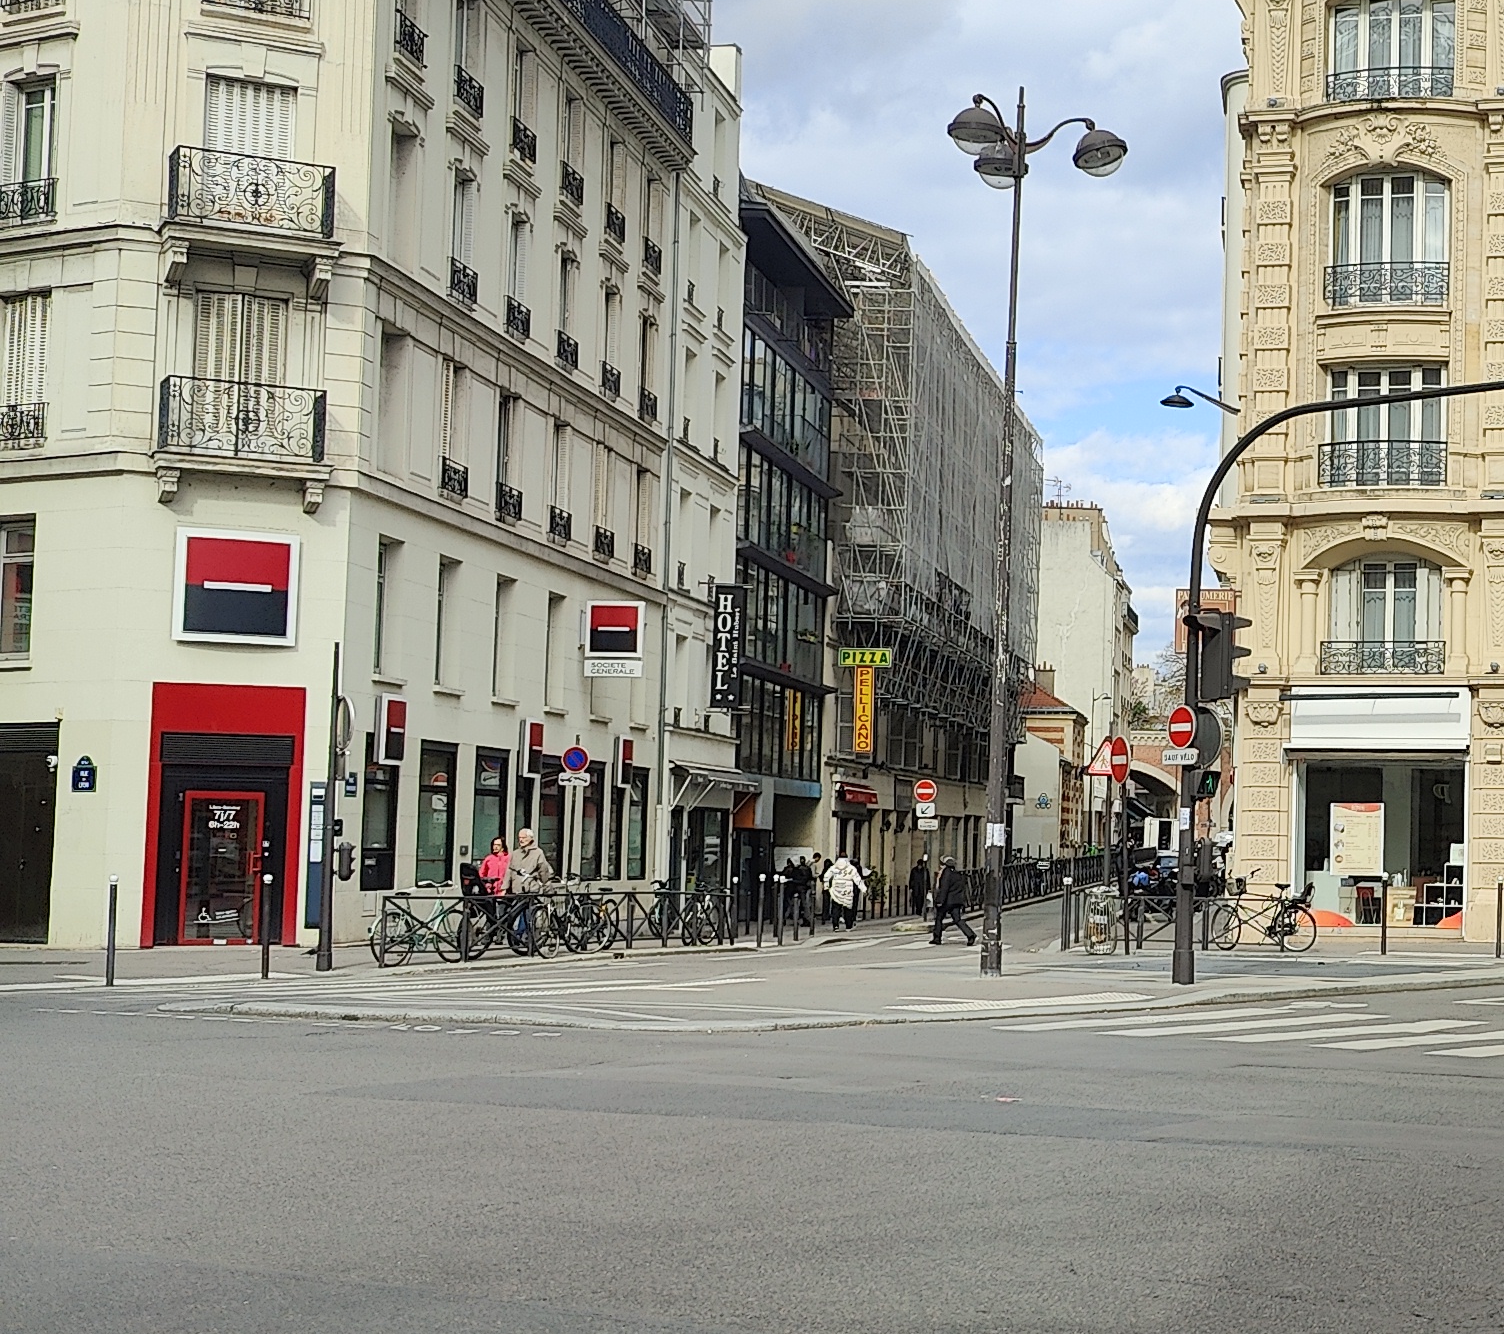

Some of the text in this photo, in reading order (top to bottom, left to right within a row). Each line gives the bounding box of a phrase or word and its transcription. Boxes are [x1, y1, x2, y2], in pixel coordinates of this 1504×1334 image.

[1177, 590, 1234, 601] PAUMERIE
[715, 594, 734, 689] HOTEL
[842, 651, 888, 664] PIZZA
[857, 669, 871, 750] PELLICANO
